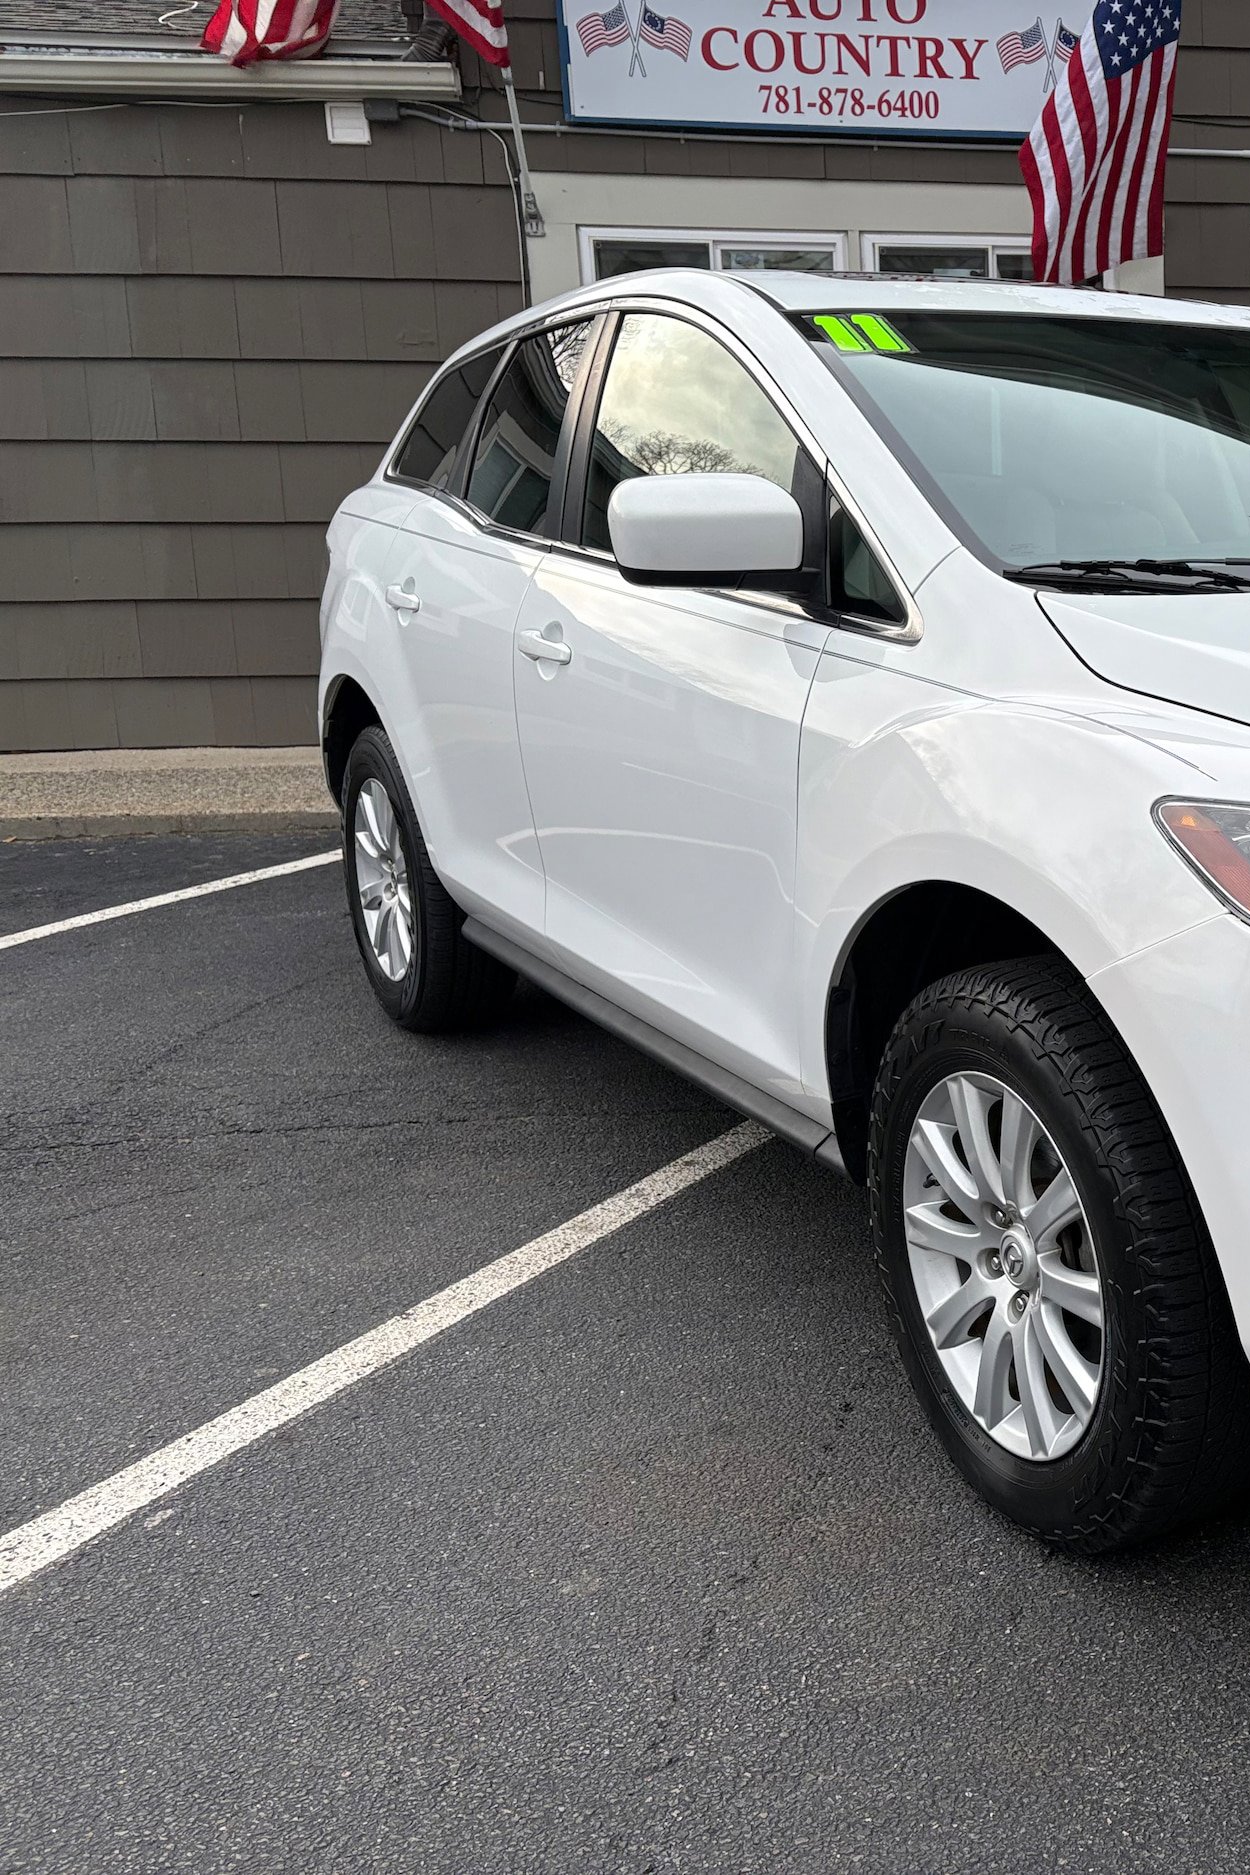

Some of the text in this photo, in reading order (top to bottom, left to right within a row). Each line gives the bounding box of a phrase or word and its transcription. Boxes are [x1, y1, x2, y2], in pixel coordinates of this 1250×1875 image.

[701, 27, 989, 80] COUNTRY
[758, 84, 940, 119] 781-878-6400
[813, 313, 912, 353] 11
